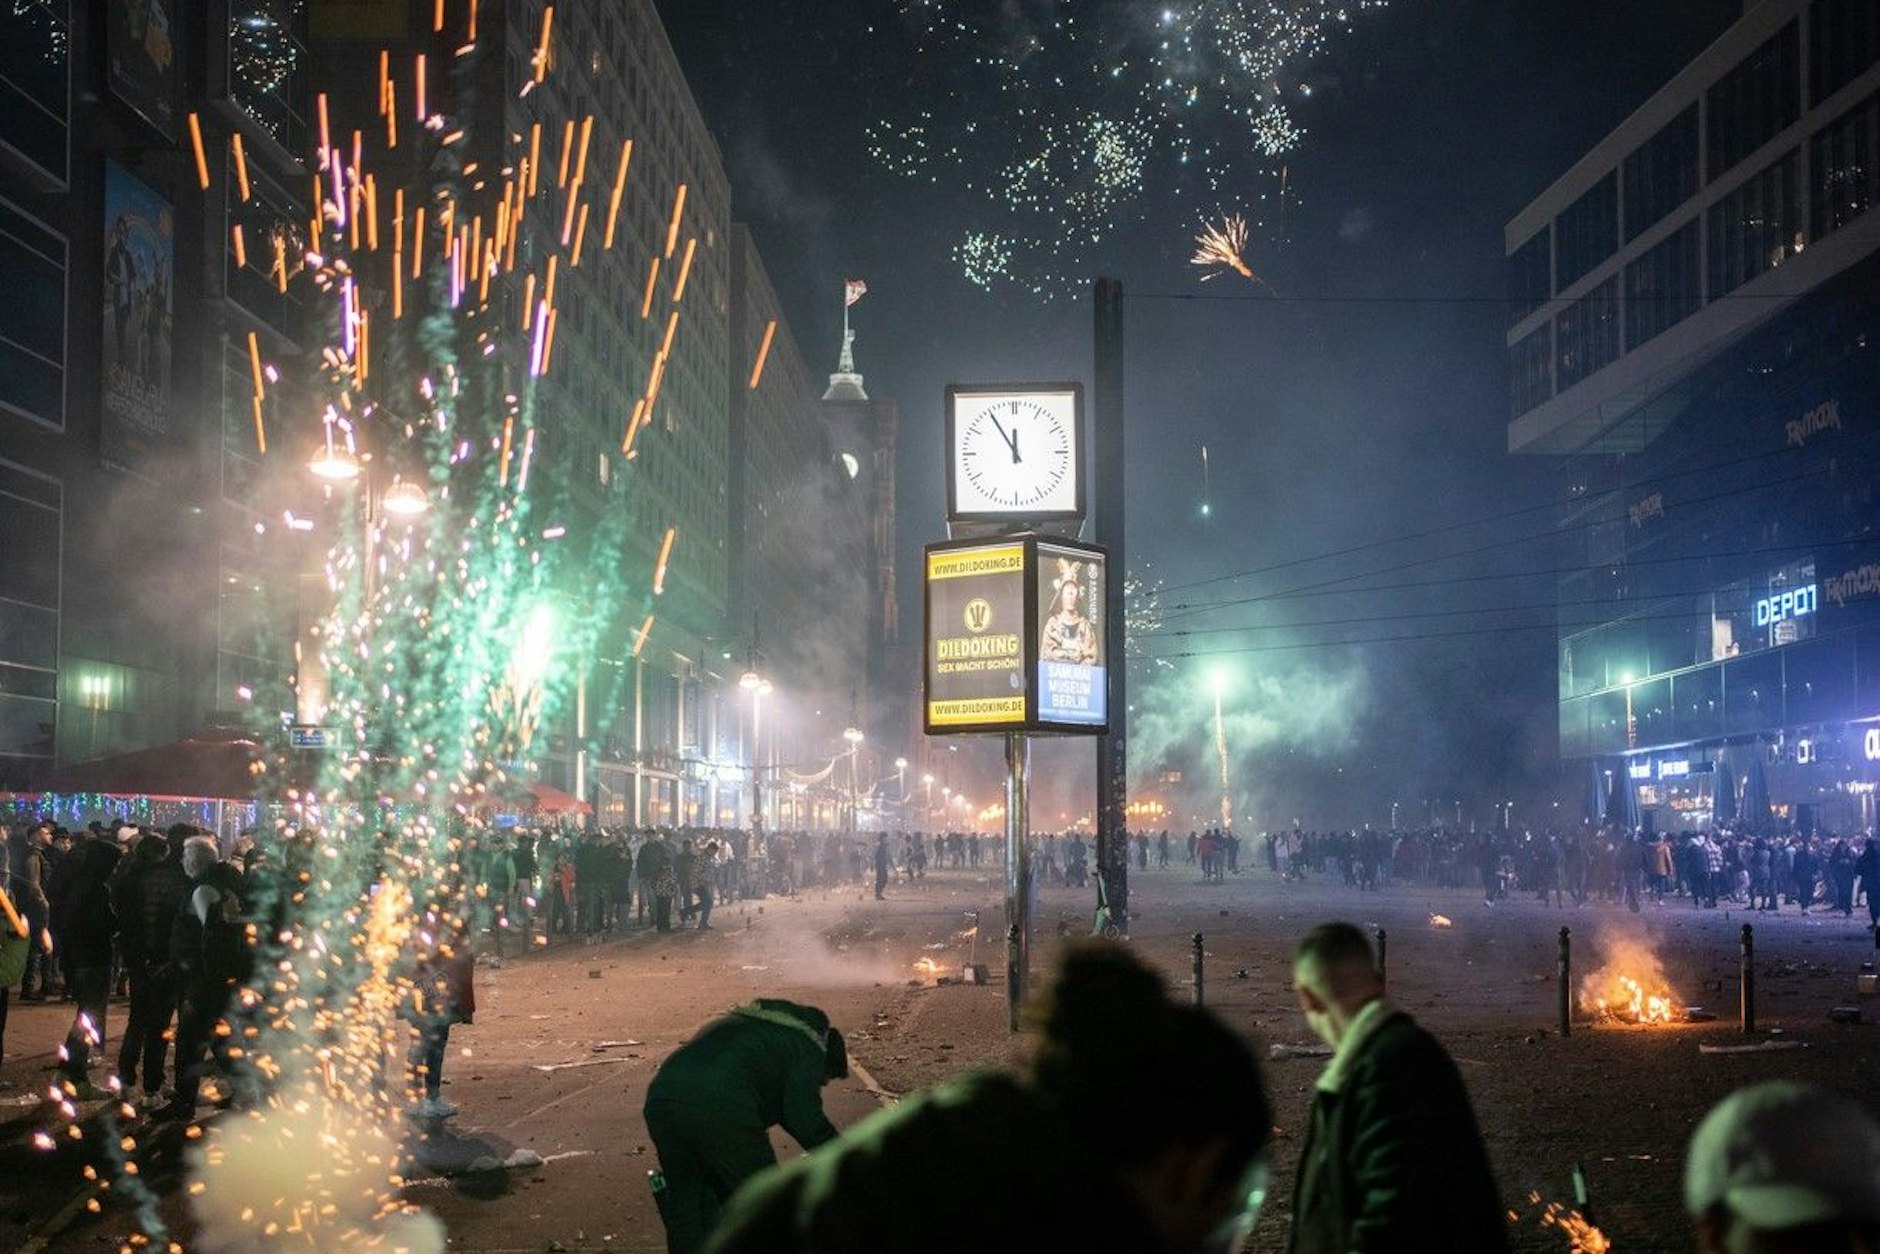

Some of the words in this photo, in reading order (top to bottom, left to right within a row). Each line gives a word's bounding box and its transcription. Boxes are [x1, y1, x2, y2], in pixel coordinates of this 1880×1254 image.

[934, 556, 1021, 575] WWW.DILDOKING.DE
[1757, 584, 1817, 626] DEPOT
[938, 634, 1018, 659] DILDOKING
[938, 661, 955, 673] SEX
[956, 659, 986, 673] MACHT
[935, 701, 1023, 715] WWW.DILDOKING.DE
[1052, 693, 1088, 710] BERLIN
